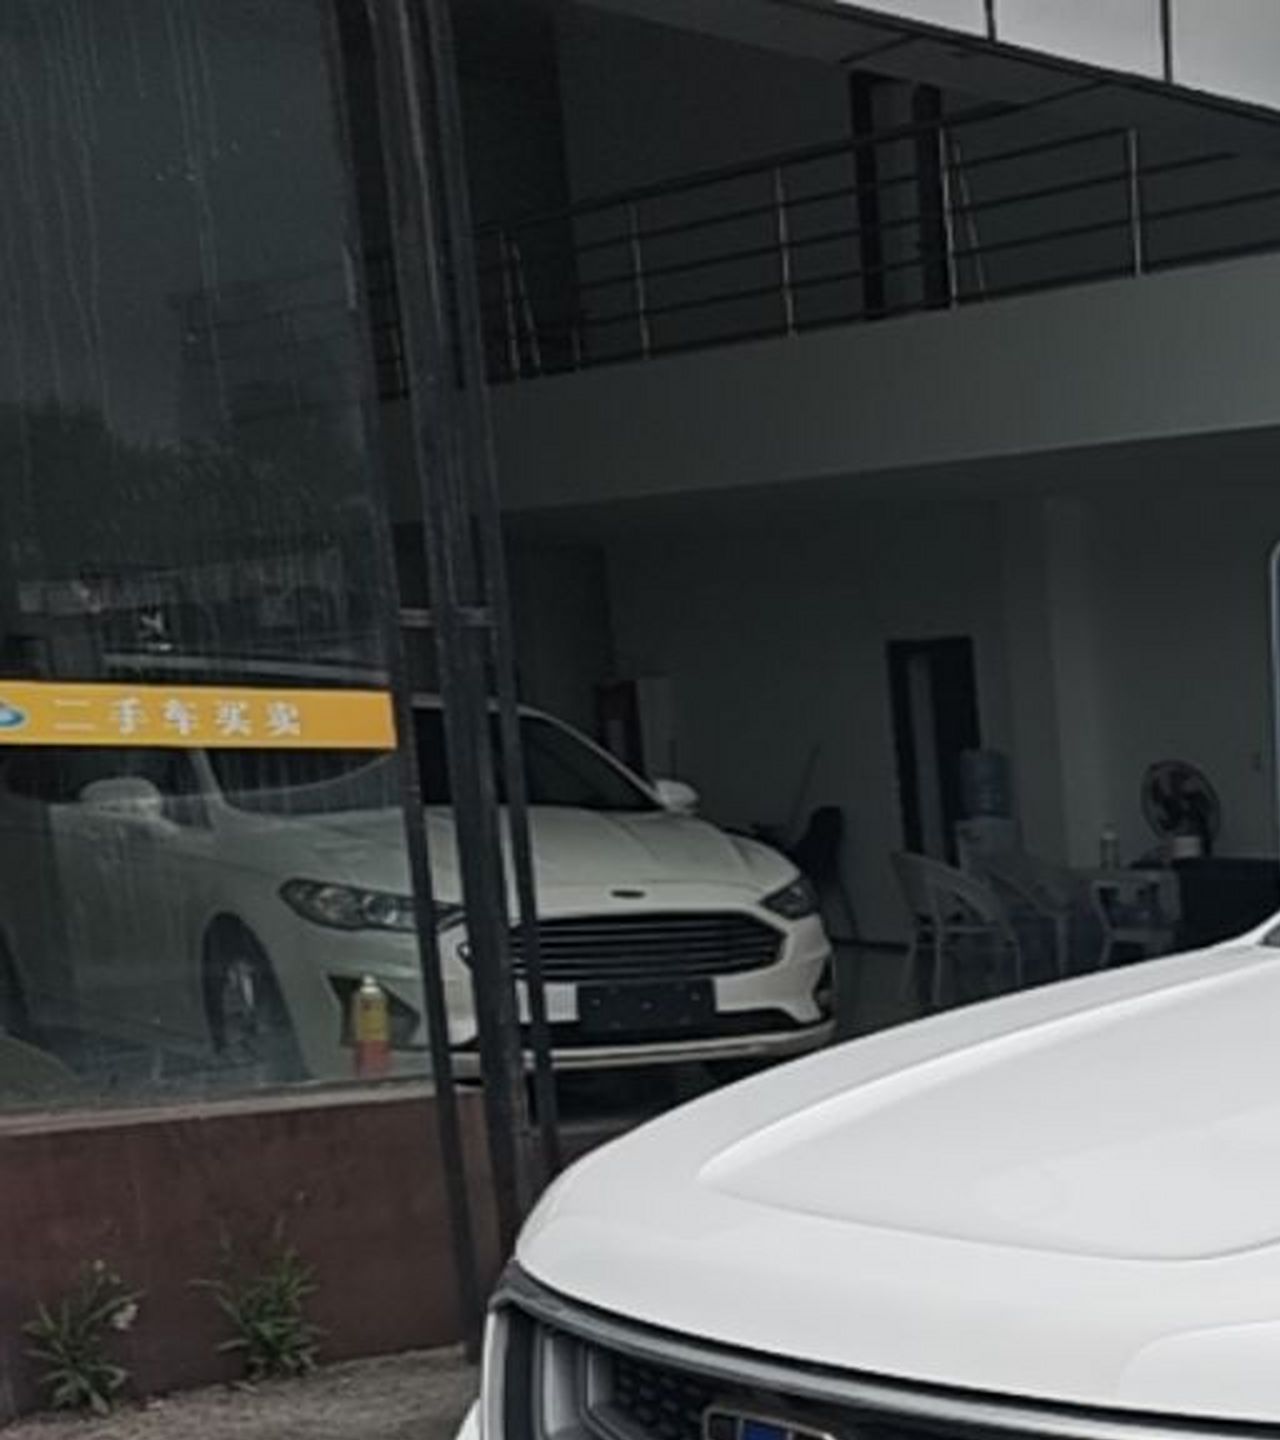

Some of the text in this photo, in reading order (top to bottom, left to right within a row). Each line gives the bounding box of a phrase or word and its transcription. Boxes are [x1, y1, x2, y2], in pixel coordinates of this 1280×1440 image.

[53, 697, 301, 737] 二手车买卖
